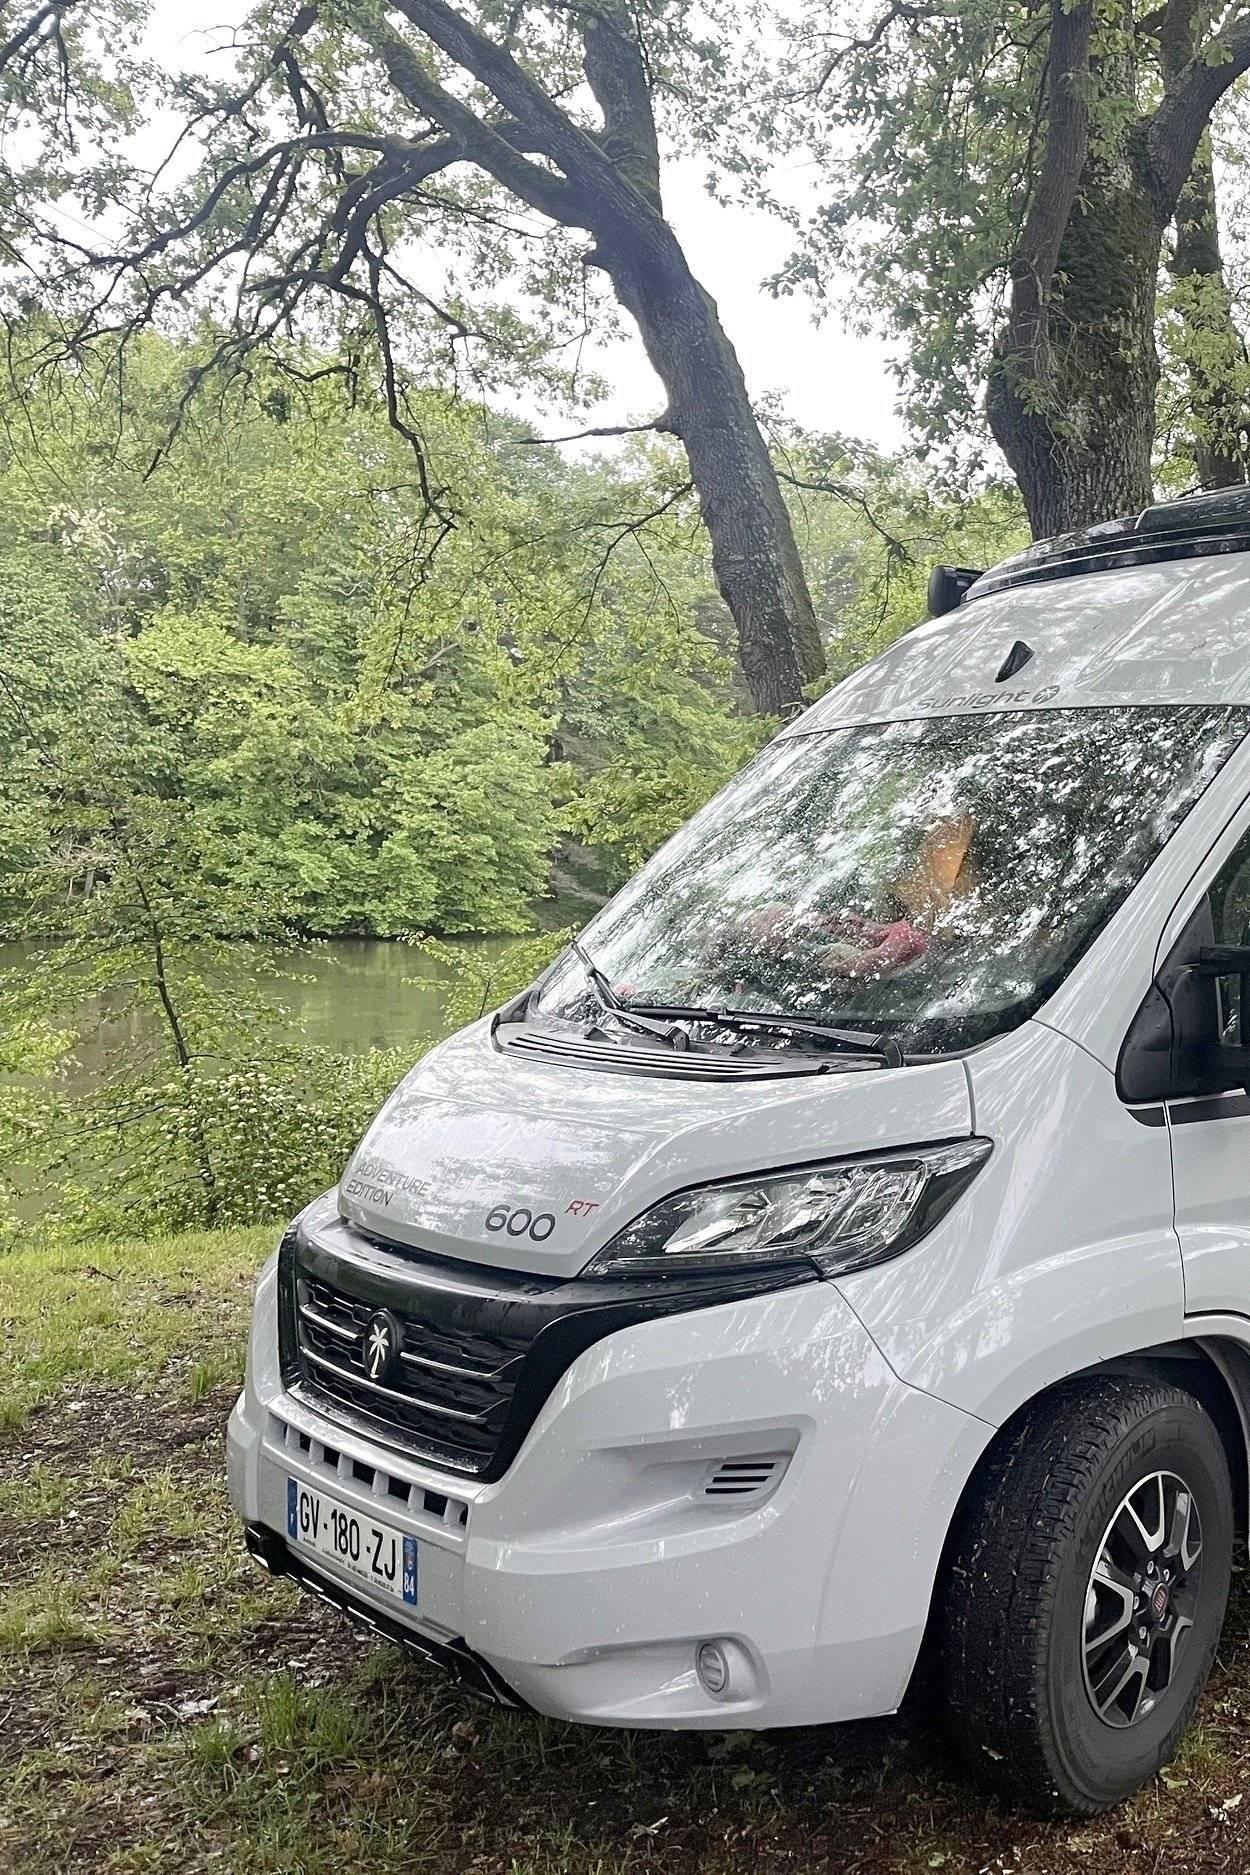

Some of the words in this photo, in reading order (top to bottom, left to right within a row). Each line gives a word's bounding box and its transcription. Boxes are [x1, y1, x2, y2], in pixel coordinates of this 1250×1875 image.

[346, 1179, 393, 1206] EDITION
[356, 1162, 432, 1197] ADVENTURE
[484, 1205, 556, 1242] 600
[565, 1200, 599, 1217] RT
[404, 1571, 415, 1597] 84
